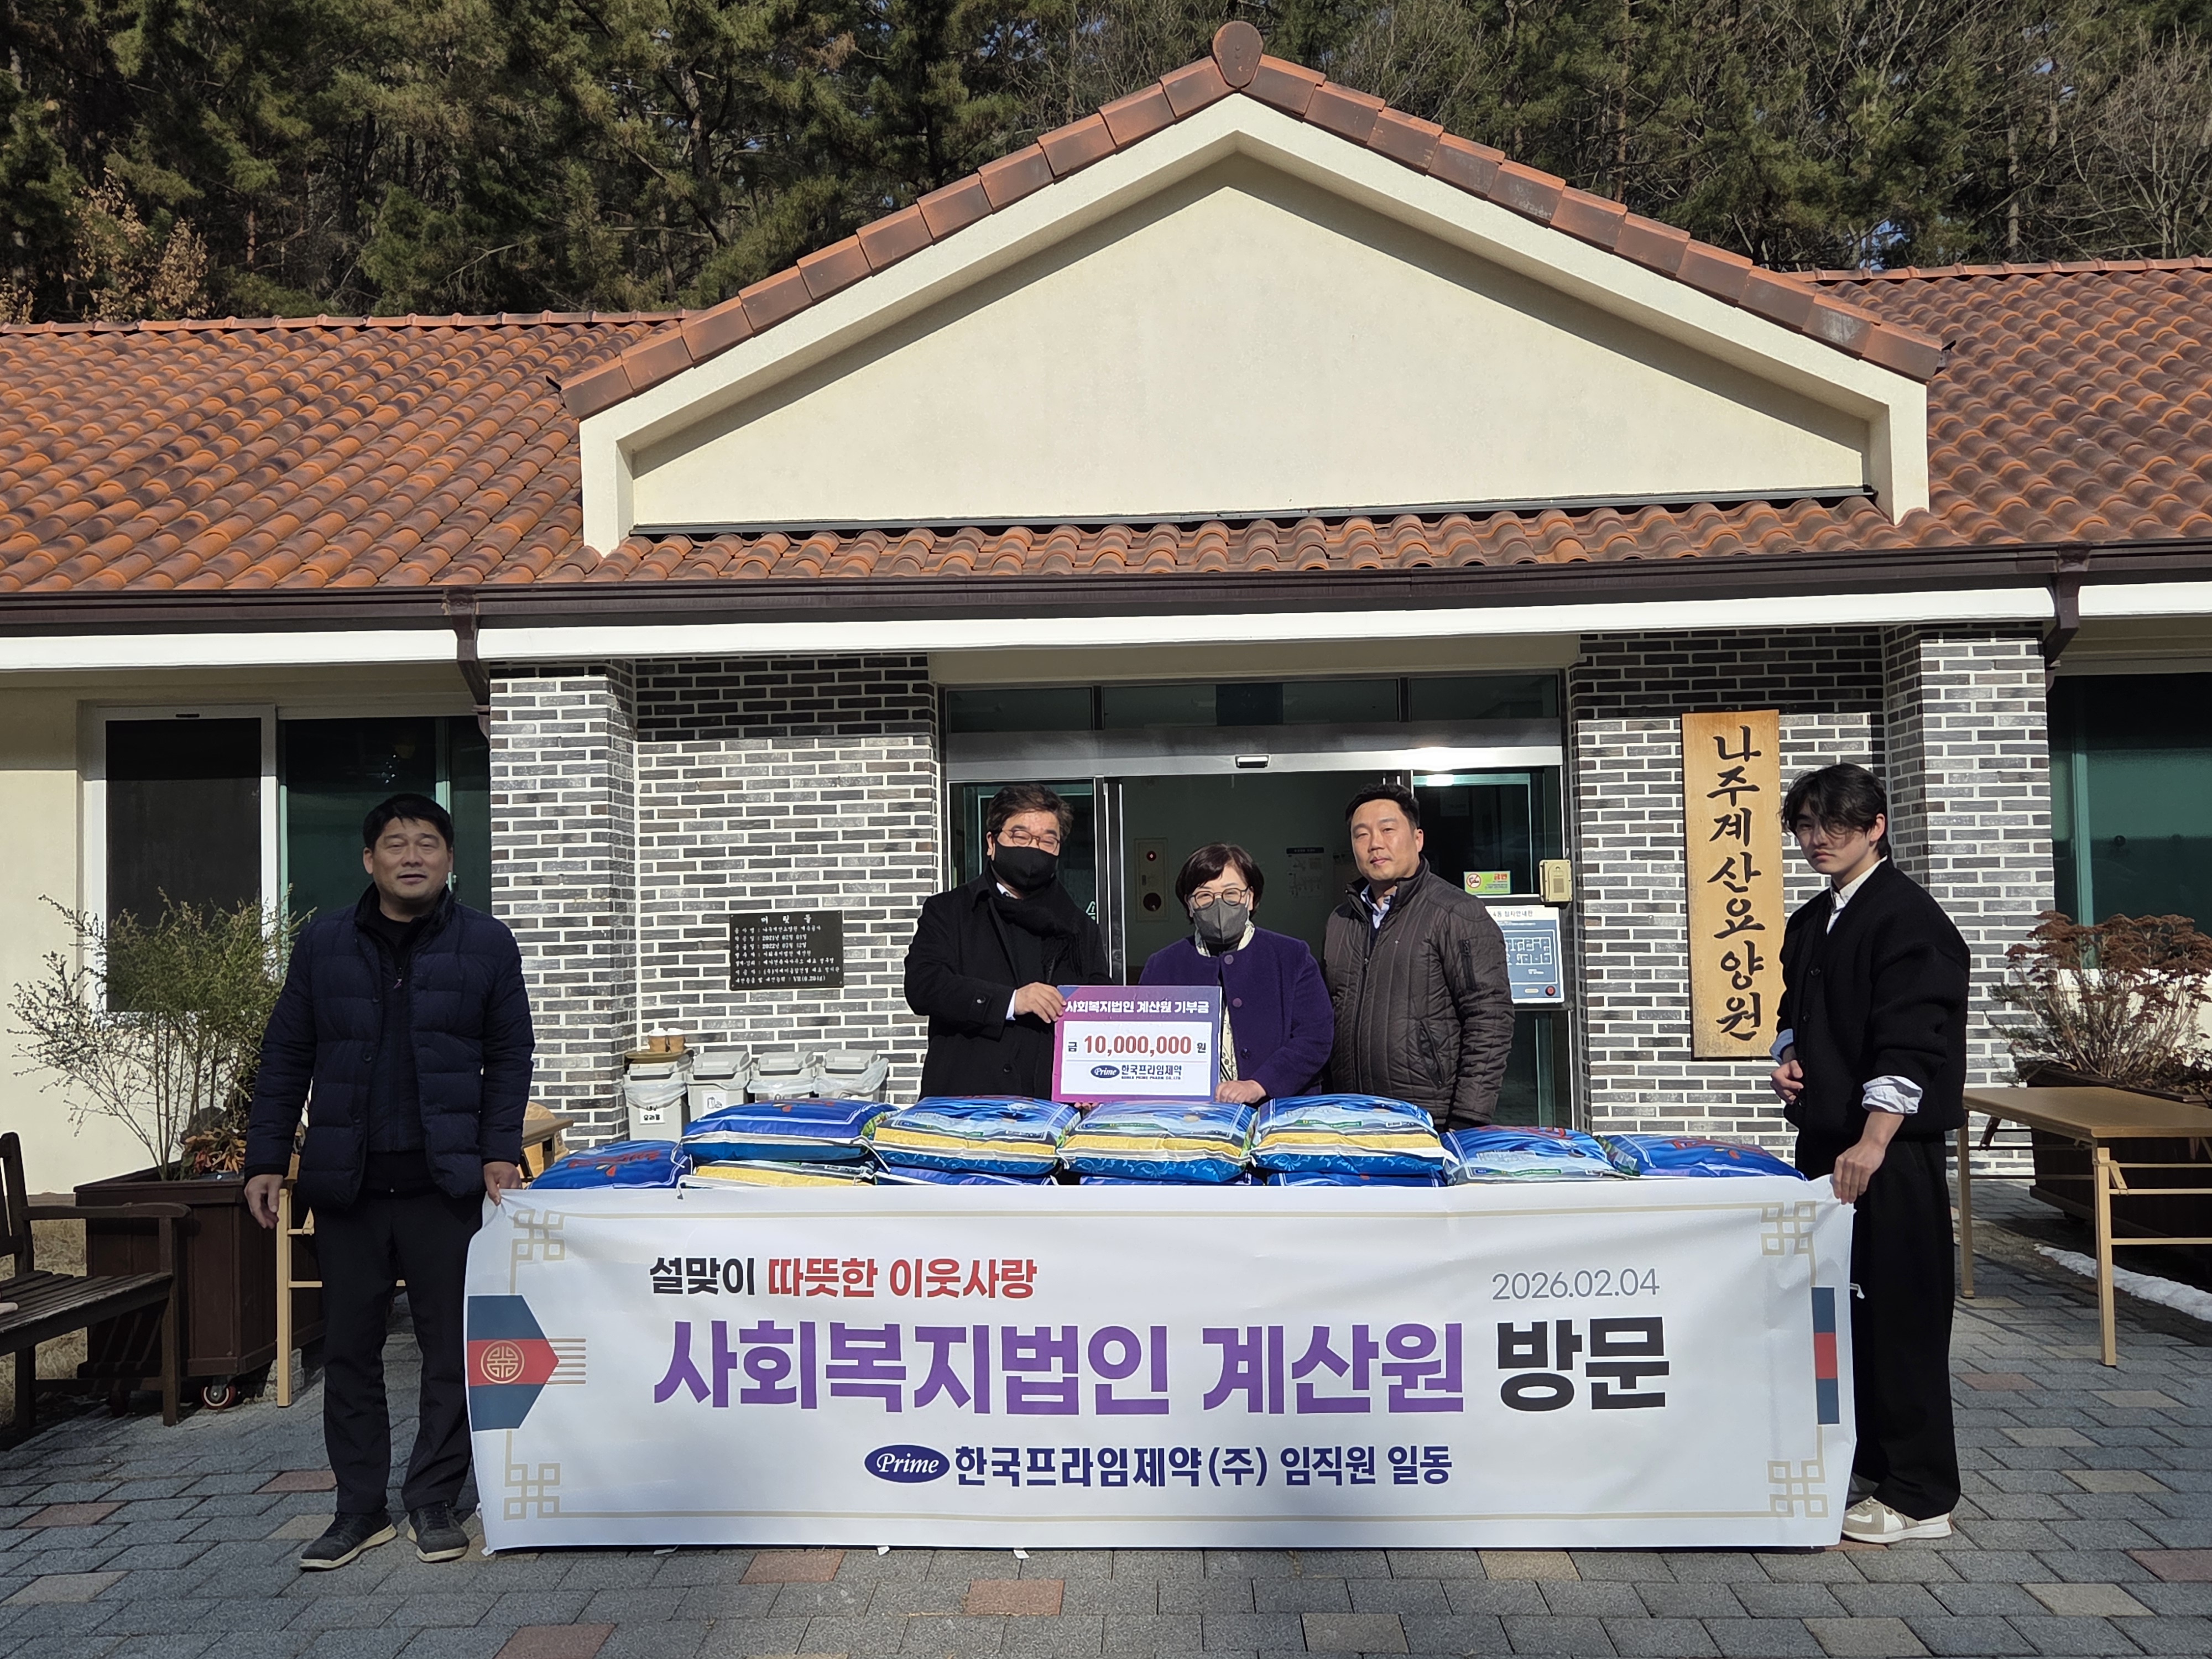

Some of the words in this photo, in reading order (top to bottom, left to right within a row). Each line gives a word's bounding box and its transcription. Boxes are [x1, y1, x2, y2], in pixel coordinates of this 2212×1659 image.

[1706, 725, 1766, 1041] 나주계산요양원
[1065, 1000, 1134, 1013] 사회복지법인
[1137, 1000, 1172, 1013] 계산원
[1175, 1001, 1209, 1014] 기부금
[1067, 1041, 1078, 1052] 금
[1084, 1035, 1191, 1057] 10,000,000
[1197, 1042, 1207, 1053] 원
[1094, 1067, 1117, 1076] Prime
[650, 1257, 755, 1296] 설맞이
[768, 1257, 878, 1297] 따뜻한
[890, 1259, 1037, 1298] 이웃사랑
[1492, 1268, 1660, 1301] 2026.02.04
[654, 1320, 1170, 1415] 사회복지법인
[1202, 1323, 1464, 1415] 계산원
[1497, 1316, 1670, 1412] 방문
[876, 1452, 940, 1474] Prime
[956, 1446, 1267, 1488] 한국프라임제약(주)
[1280, 1446, 1376, 1486] 임직원
[1387, 1446, 1452, 1485] 일동
